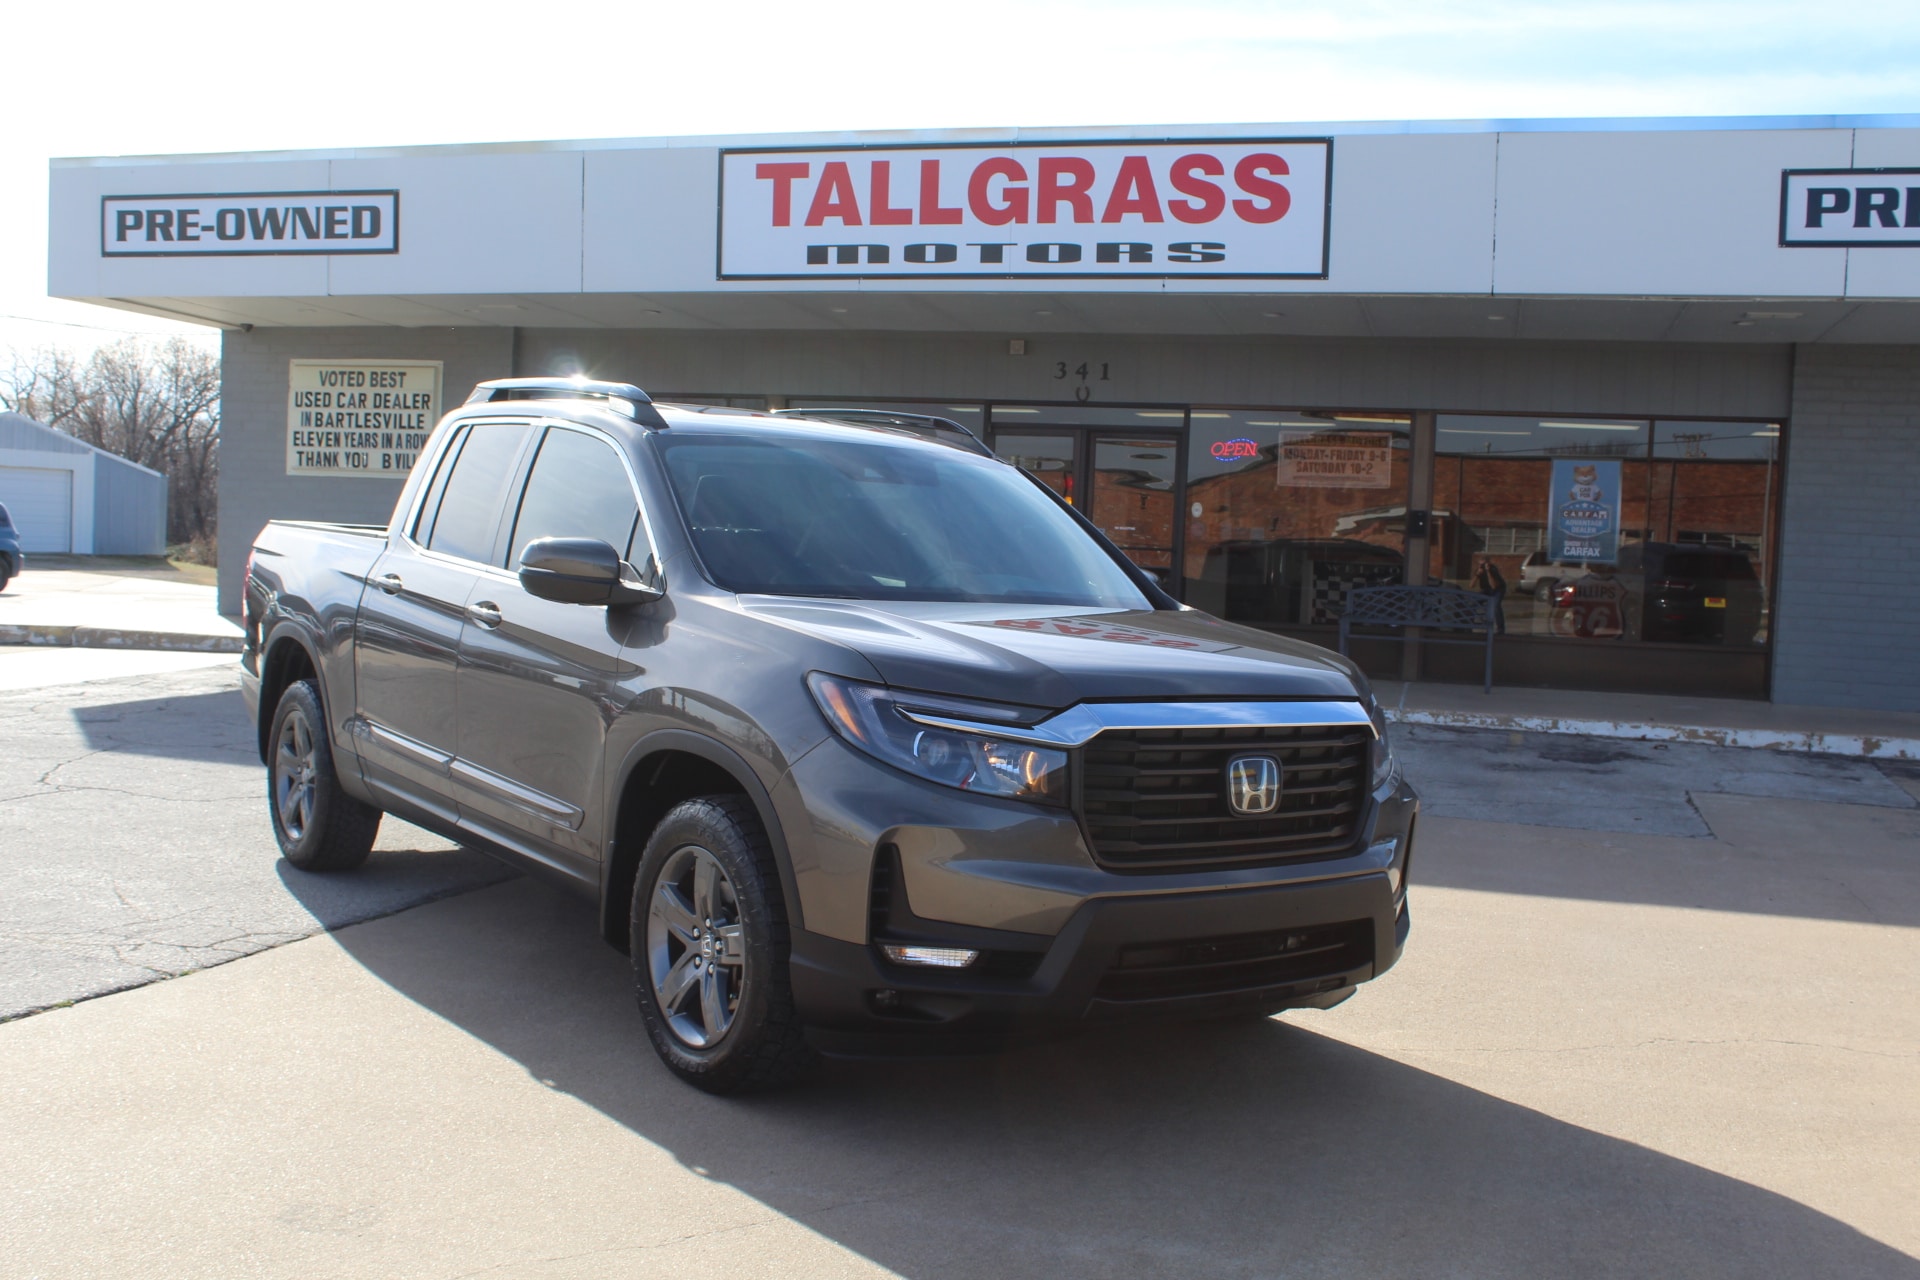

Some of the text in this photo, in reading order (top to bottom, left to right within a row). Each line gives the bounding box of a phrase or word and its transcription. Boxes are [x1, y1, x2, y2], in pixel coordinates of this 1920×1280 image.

[755, 153, 1291, 227] TALLGRASS
[116, 205, 381, 242] PRE-OWNED
[806, 241, 1226, 265] MOTORS
[319, 370, 406, 388] VOTED BEST
[1054, 362, 1110, 381] 341
[295, 391, 431, 410] USED CAR DEALER
[301, 411, 425, 429] IN BARTLESVILLE
[293, 431, 340, 447] ELEVEN
[344, 432, 378, 448] YEARS
[382, 433, 392, 448] IN
[396, 433, 403, 448] A
[1211, 441, 1258, 457] OPEN
[297, 451, 339, 467] THANK
[345, 452, 369, 468] YOU
[1296, 462, 1374, 475] SATURDAY 10-2
[1564, 547, 1601, 557] CARFAX
